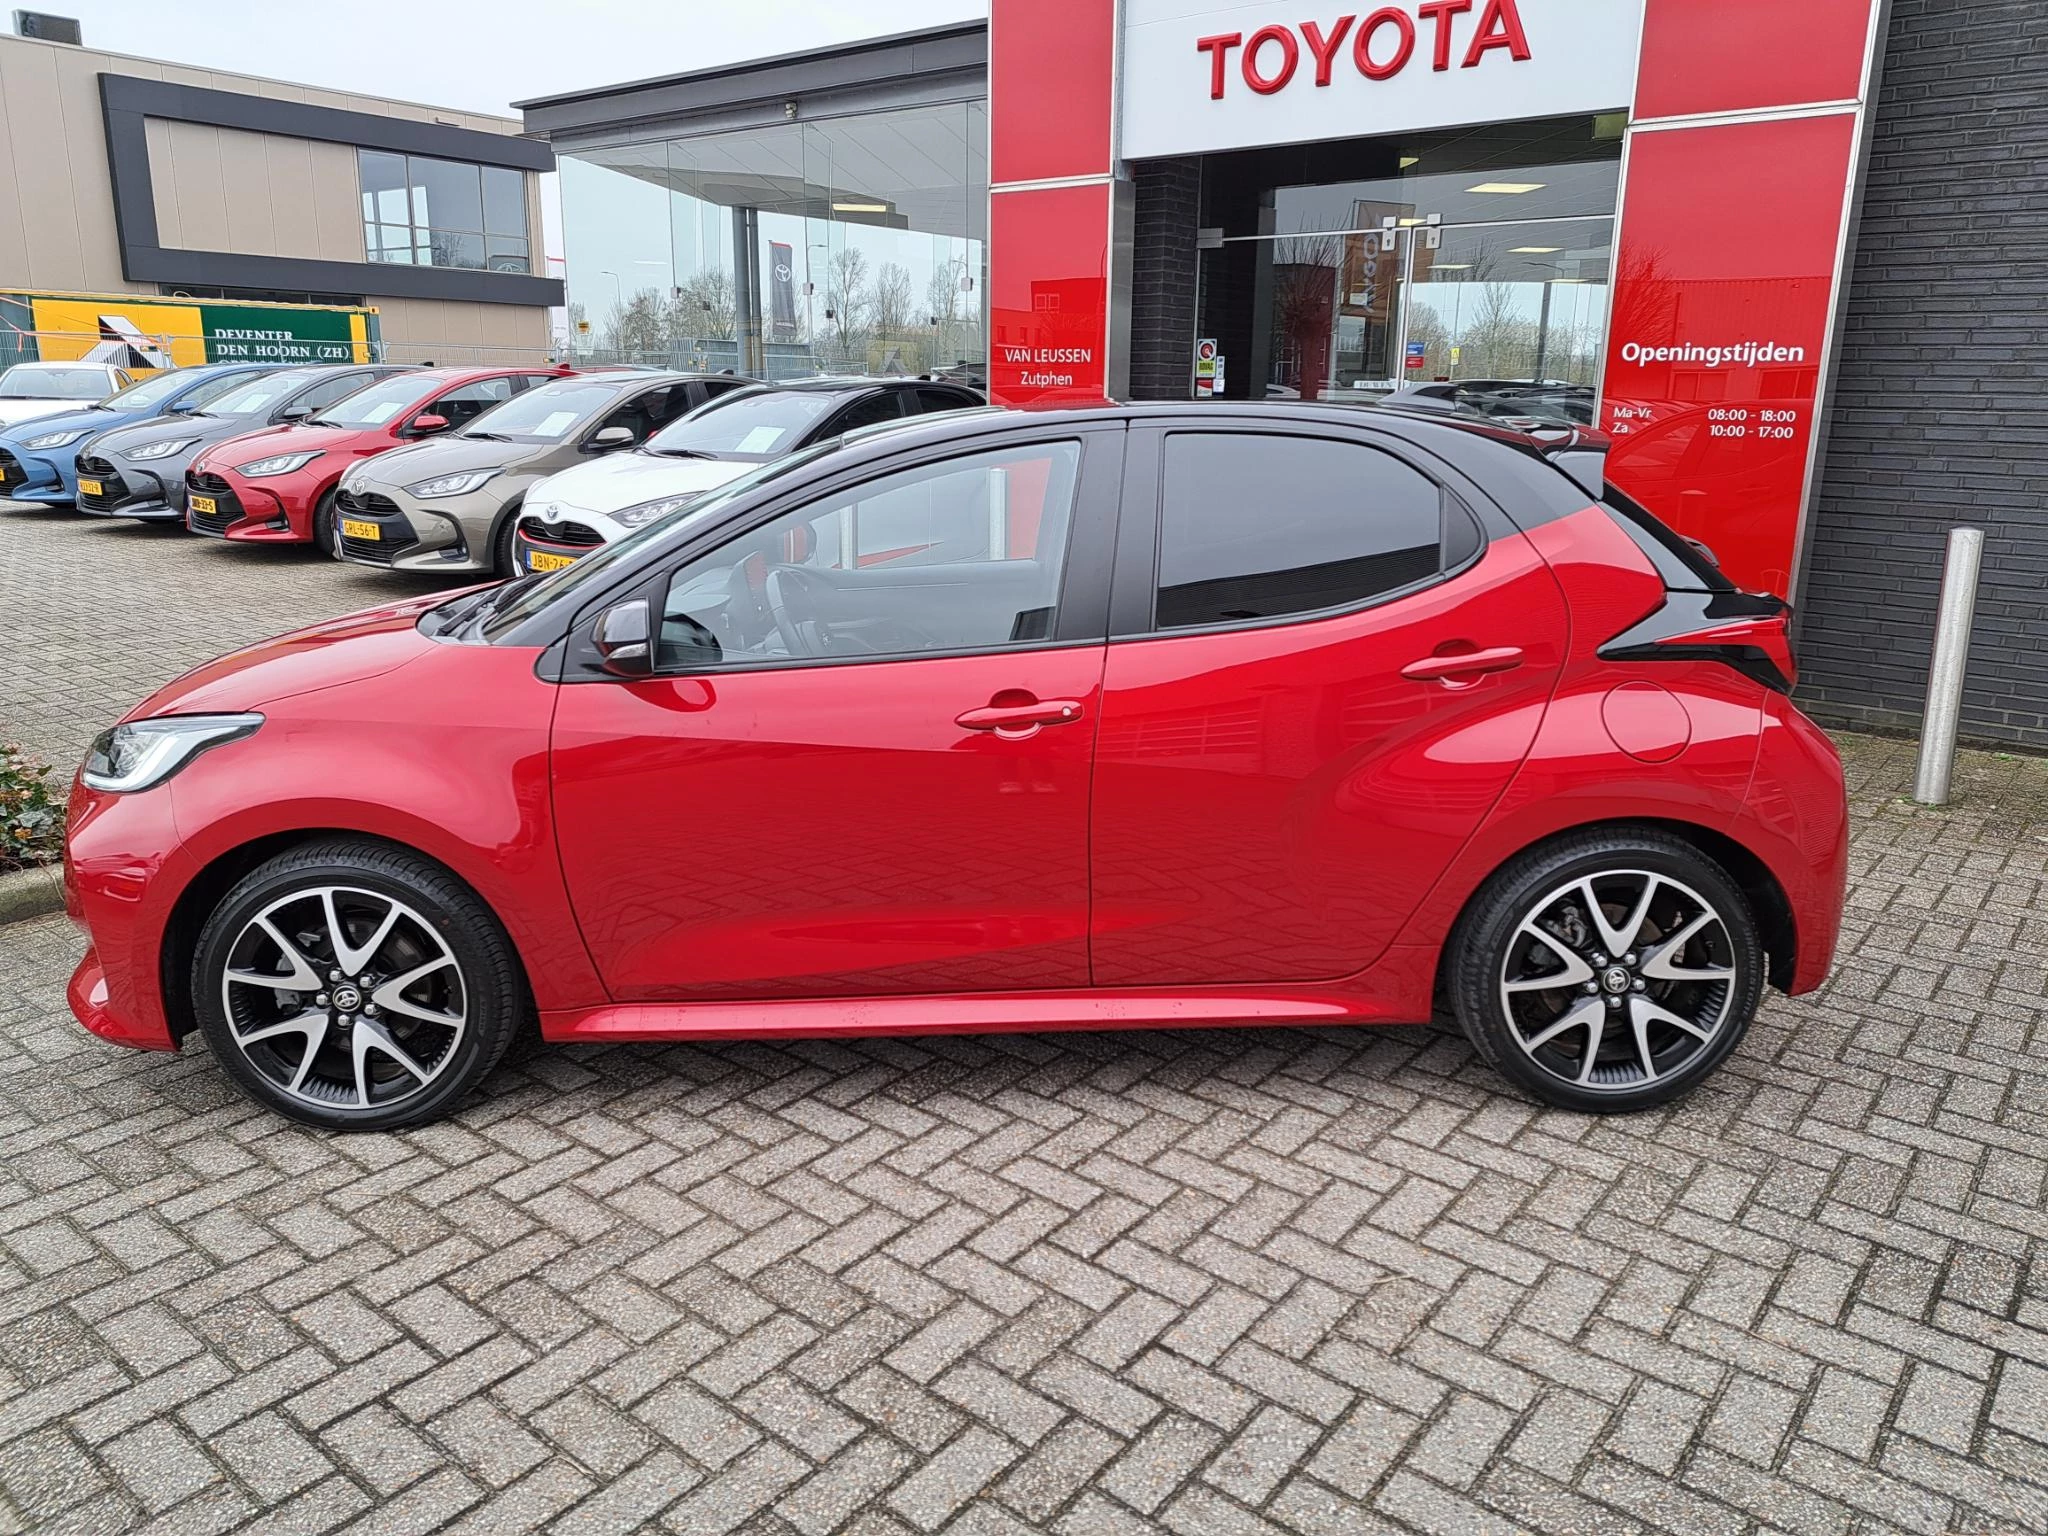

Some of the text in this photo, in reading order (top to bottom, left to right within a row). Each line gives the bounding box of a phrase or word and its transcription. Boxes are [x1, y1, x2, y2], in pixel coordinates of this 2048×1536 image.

[1197, 0, 1532, 100] TOYOTA
[214, 328, 293, 341] DEVENTER
[216, 344, 349, 360] DEN HOORN (ZH)
[1004, 348, 1092, 363] VAN LEUSSEN
[1621, 341, 1804, 367] Openingstijden
[1020, 370, 1073, 388] Zutphen
[1613, 406, 1652, 419] Ma-Vr
[1708, 408, 1747, 421] 08:00
[1760, 409, 1796, 423] 18:00
[1612, 422, 1629, 434] Za
[1709, 424, 1745, 437] 10:00
[1758, 425, 1794, 439] 17:00
